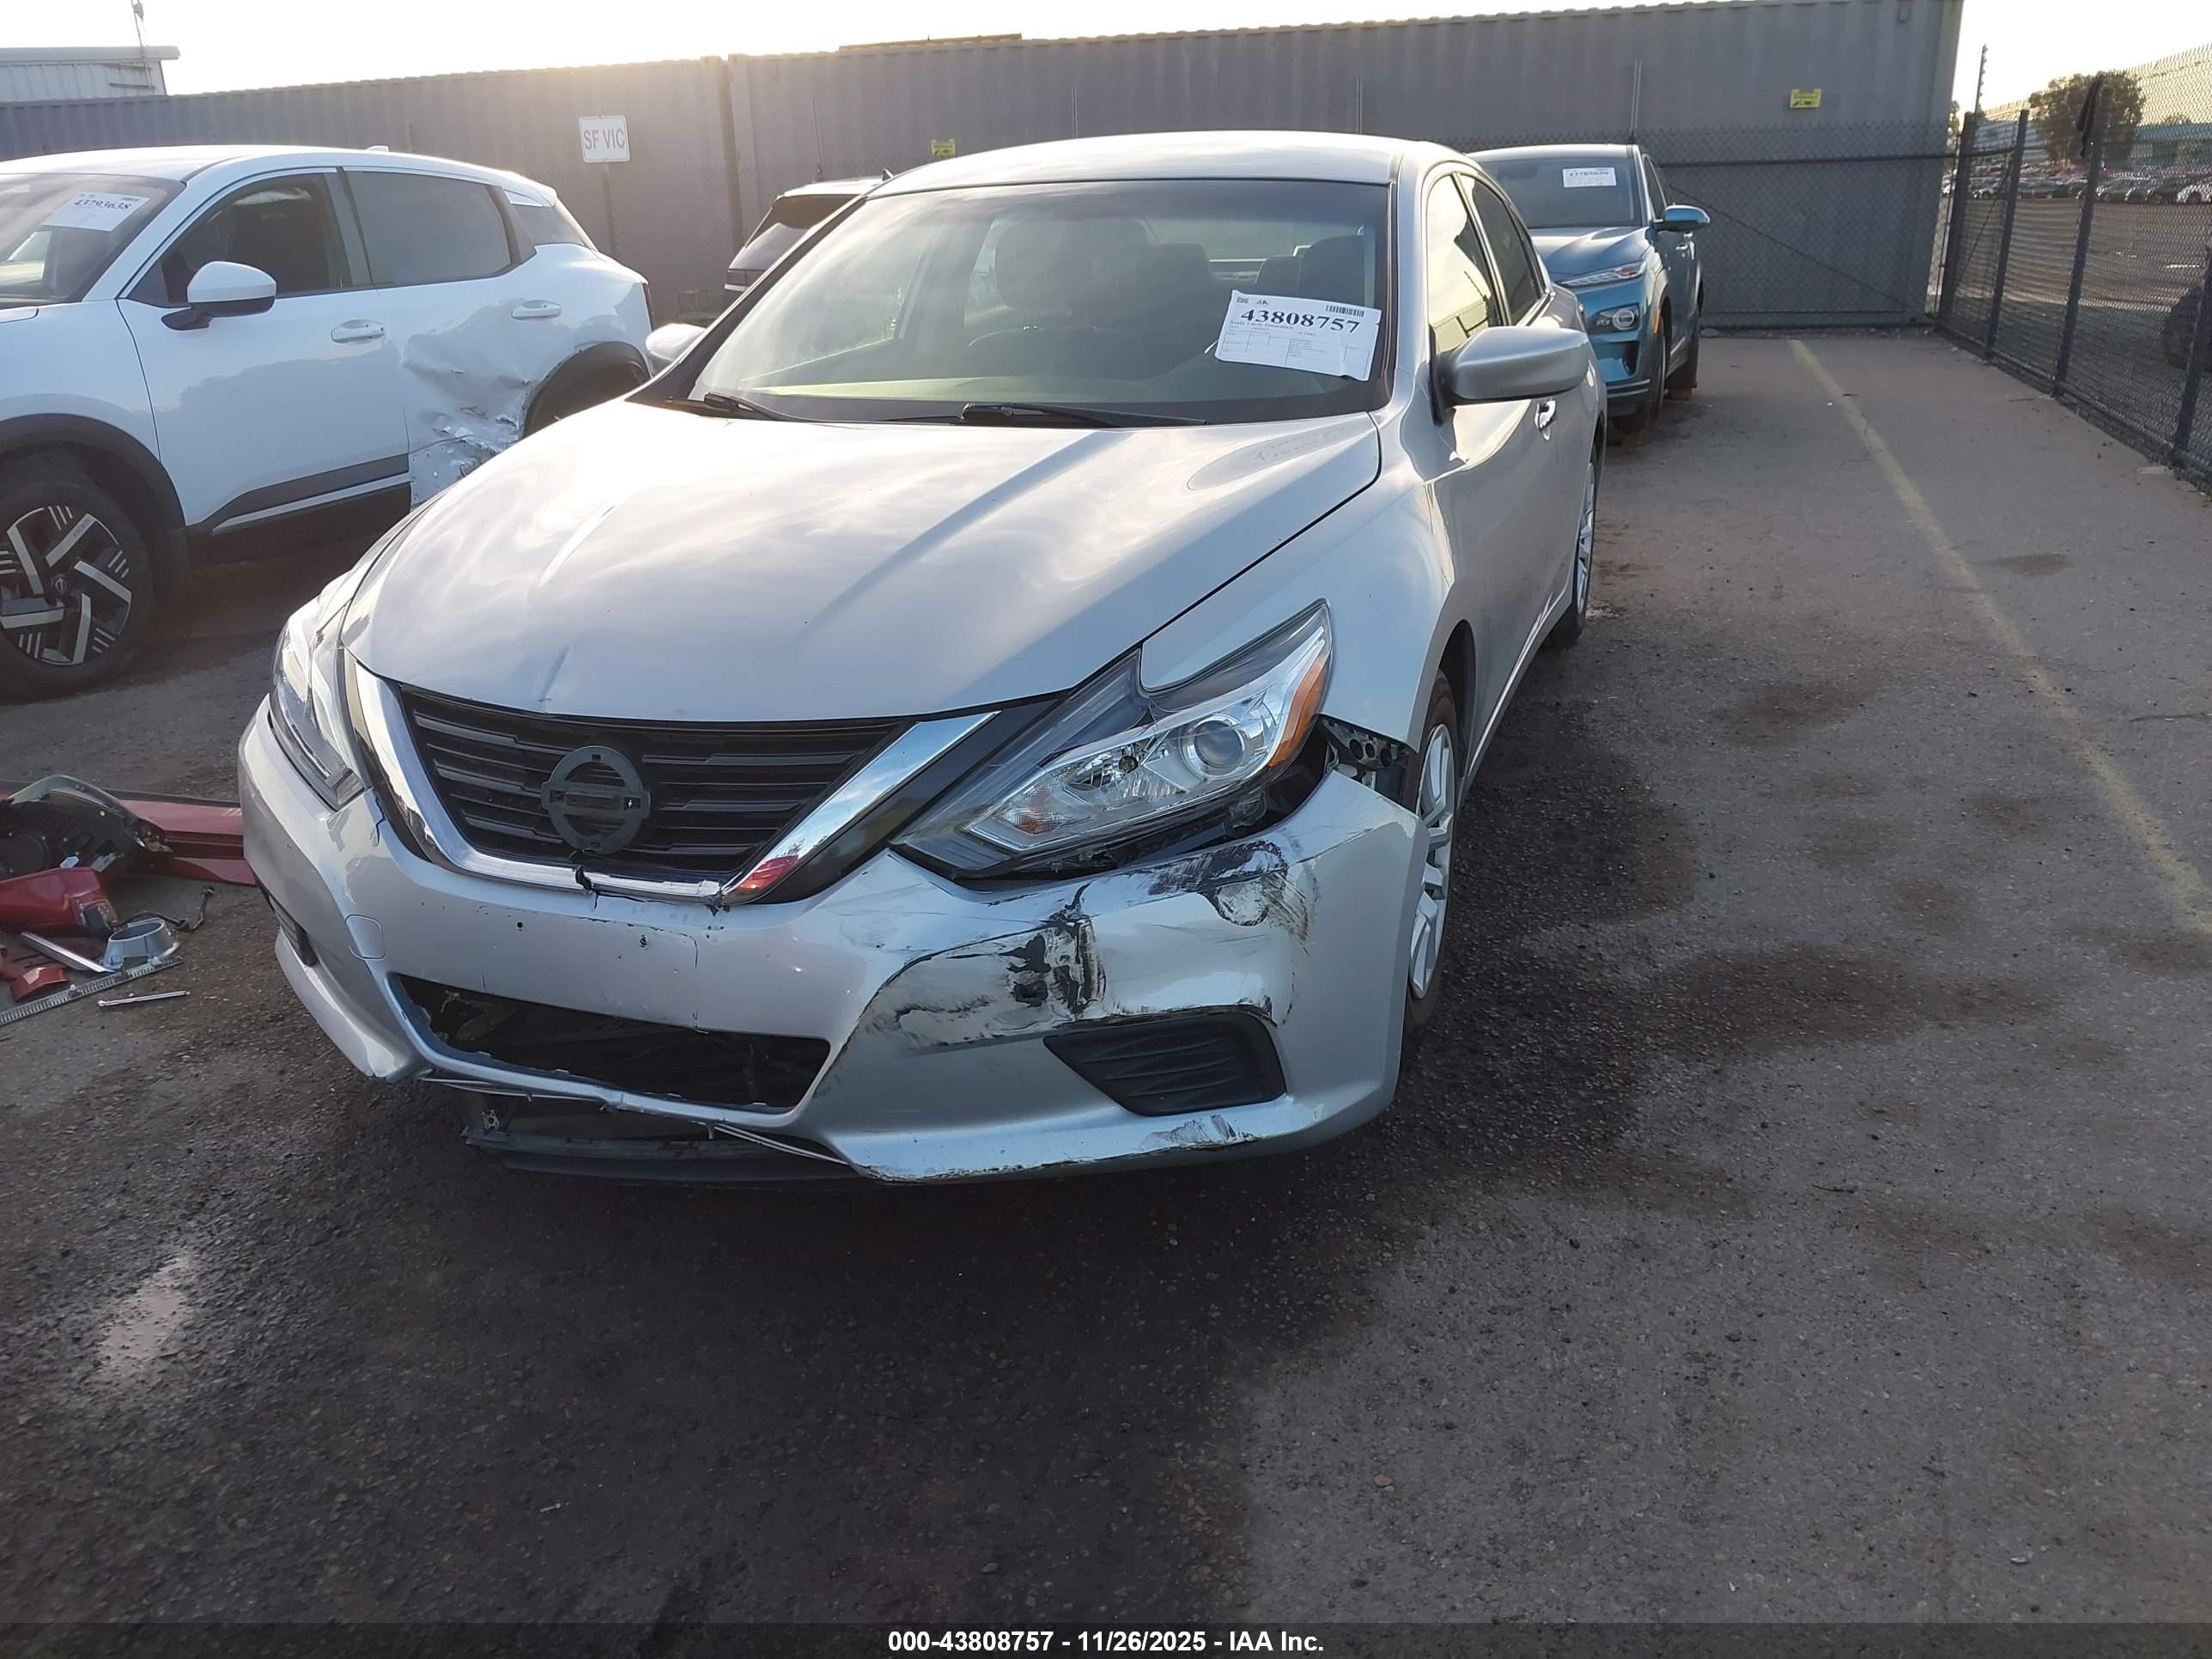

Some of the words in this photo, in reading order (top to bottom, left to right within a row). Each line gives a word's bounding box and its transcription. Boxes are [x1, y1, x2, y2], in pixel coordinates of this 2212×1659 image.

[583, 129, 599, 150] SF
[602, 129, 626, 150] VIC
[1241, 309, 1360, 333] 43808757
